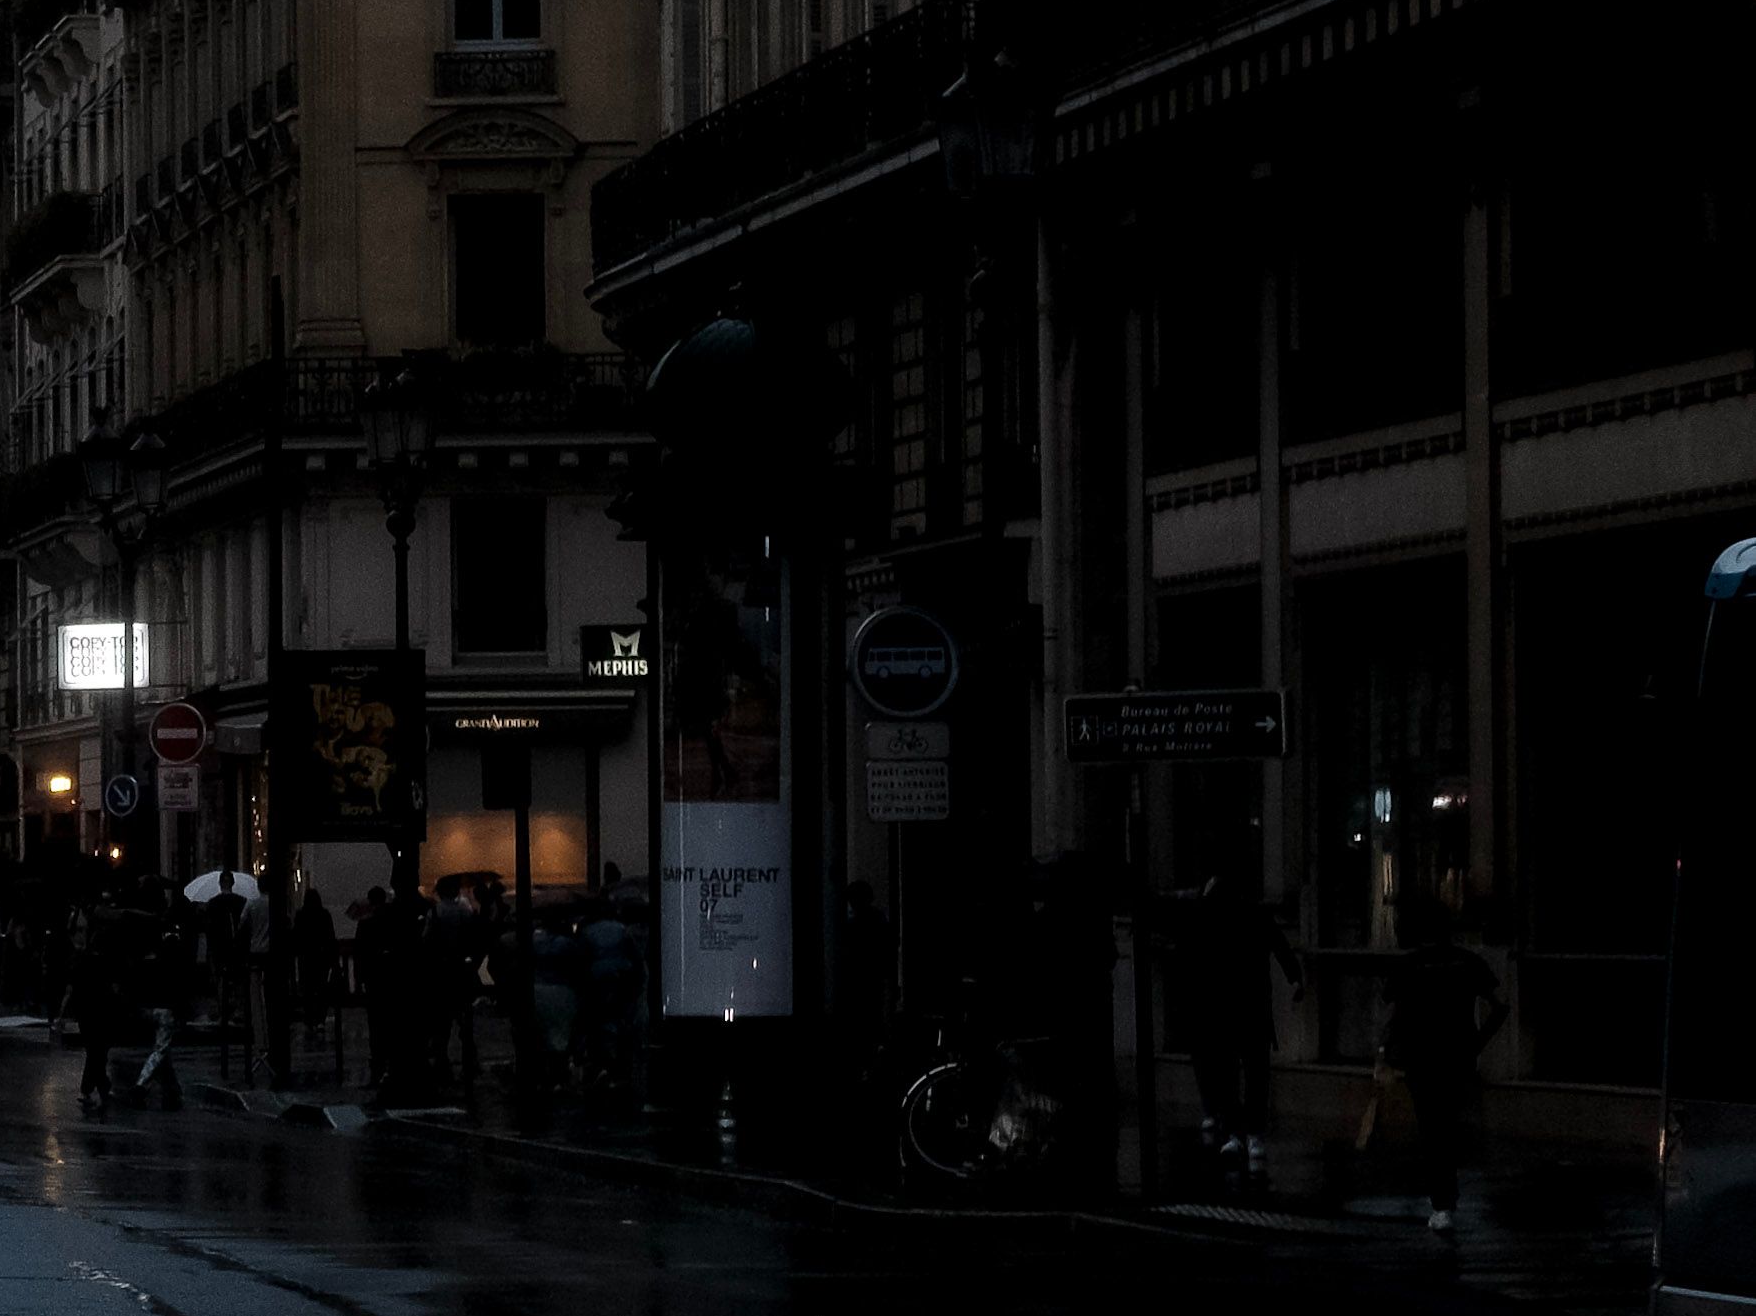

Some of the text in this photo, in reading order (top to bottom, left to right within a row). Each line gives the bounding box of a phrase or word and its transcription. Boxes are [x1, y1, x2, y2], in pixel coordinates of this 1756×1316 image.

[1120, 701, 1233, 718] Bureau de Poste
[1122, 720, 1232, 736] PALAIS ROYAL
[662, 867, 781, 884] SAINT LAURENT
[699, 883, 745, 899] SELF
[699, 898, 718, 913] 07
